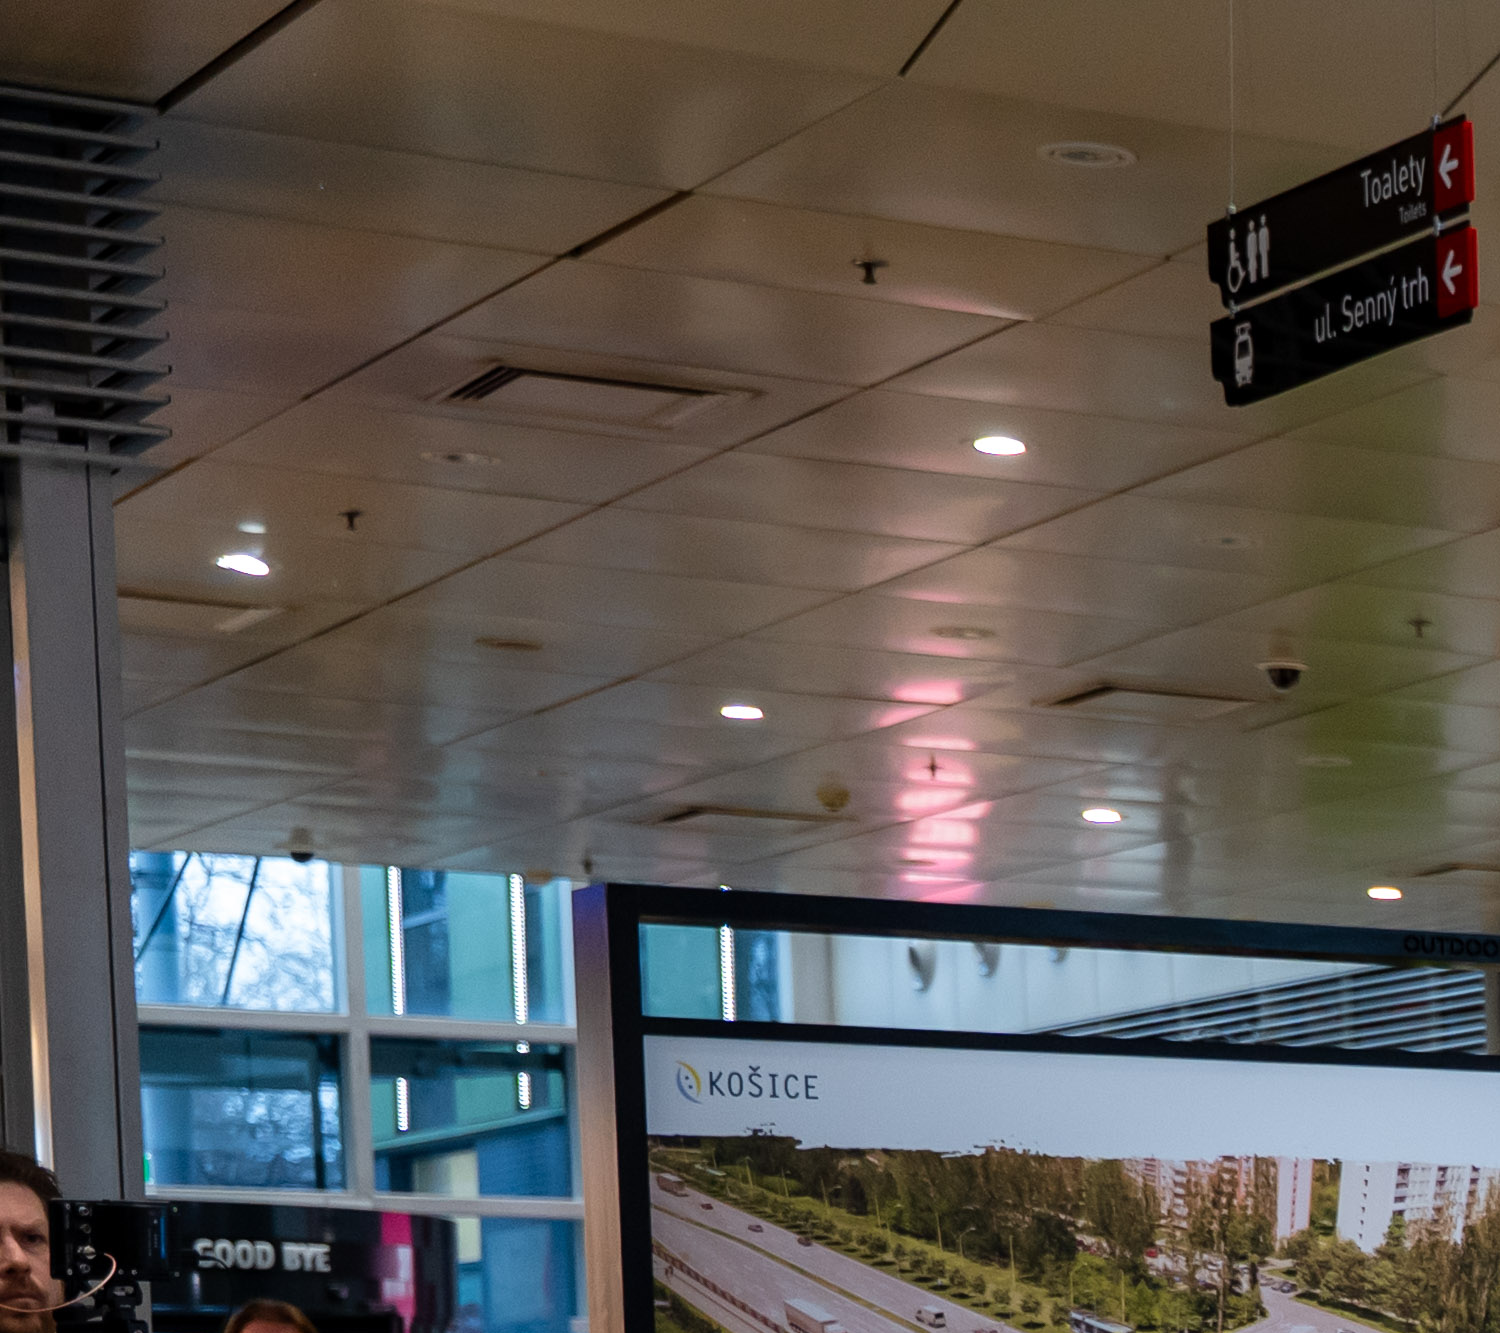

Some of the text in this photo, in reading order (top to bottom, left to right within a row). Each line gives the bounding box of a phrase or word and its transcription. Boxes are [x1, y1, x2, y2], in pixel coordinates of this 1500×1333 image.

[1361, 154, 1426, 208] Toalety
[1399, 202, 1427, 225] Toilets
[1314, 267, 1429, 343] ul. Senný trh
[709, 1065, 819, 1100] KOŠICE
[281, 1241, 332, 1273] BYE
